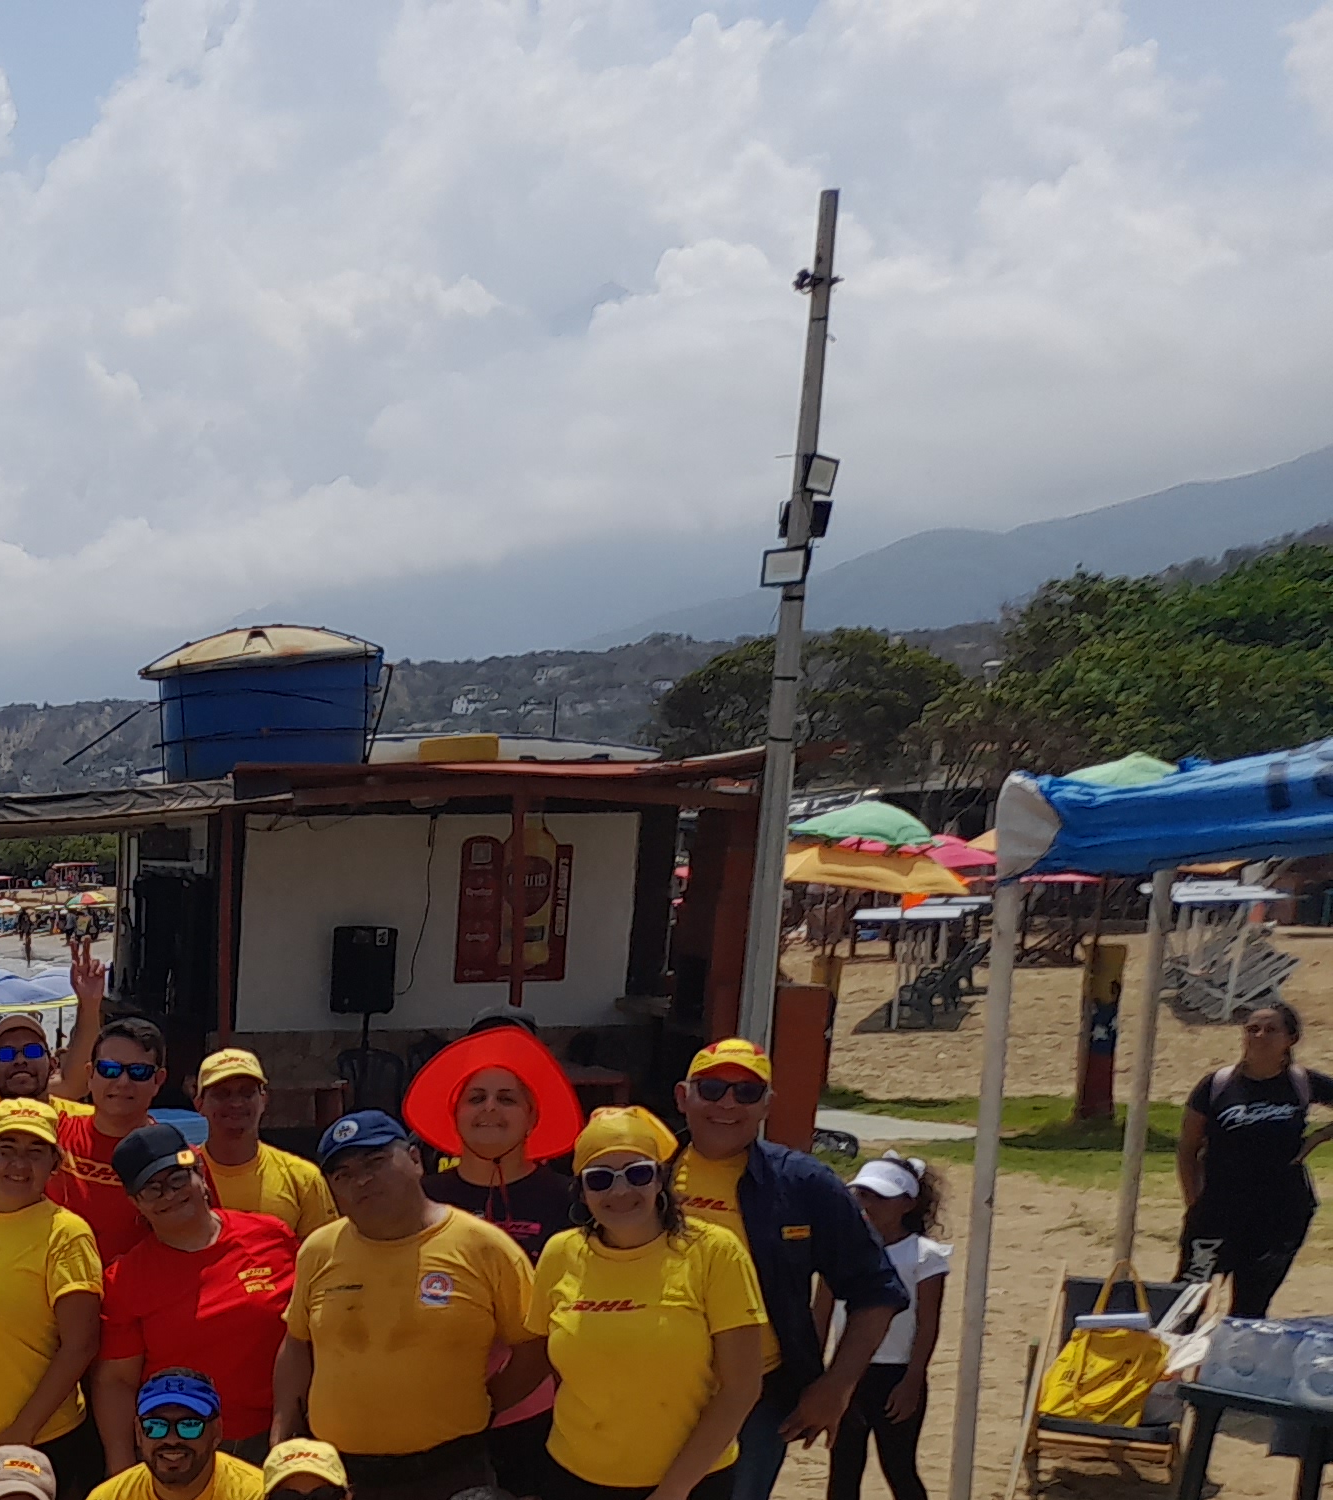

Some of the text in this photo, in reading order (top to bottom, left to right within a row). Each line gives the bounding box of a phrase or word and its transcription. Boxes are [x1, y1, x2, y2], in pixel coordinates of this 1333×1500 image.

[573, 1299, 636, 1313] DHL
[282, 1451, 324, 1464] DHL
[9, 1460, 39, 1474] DHL
